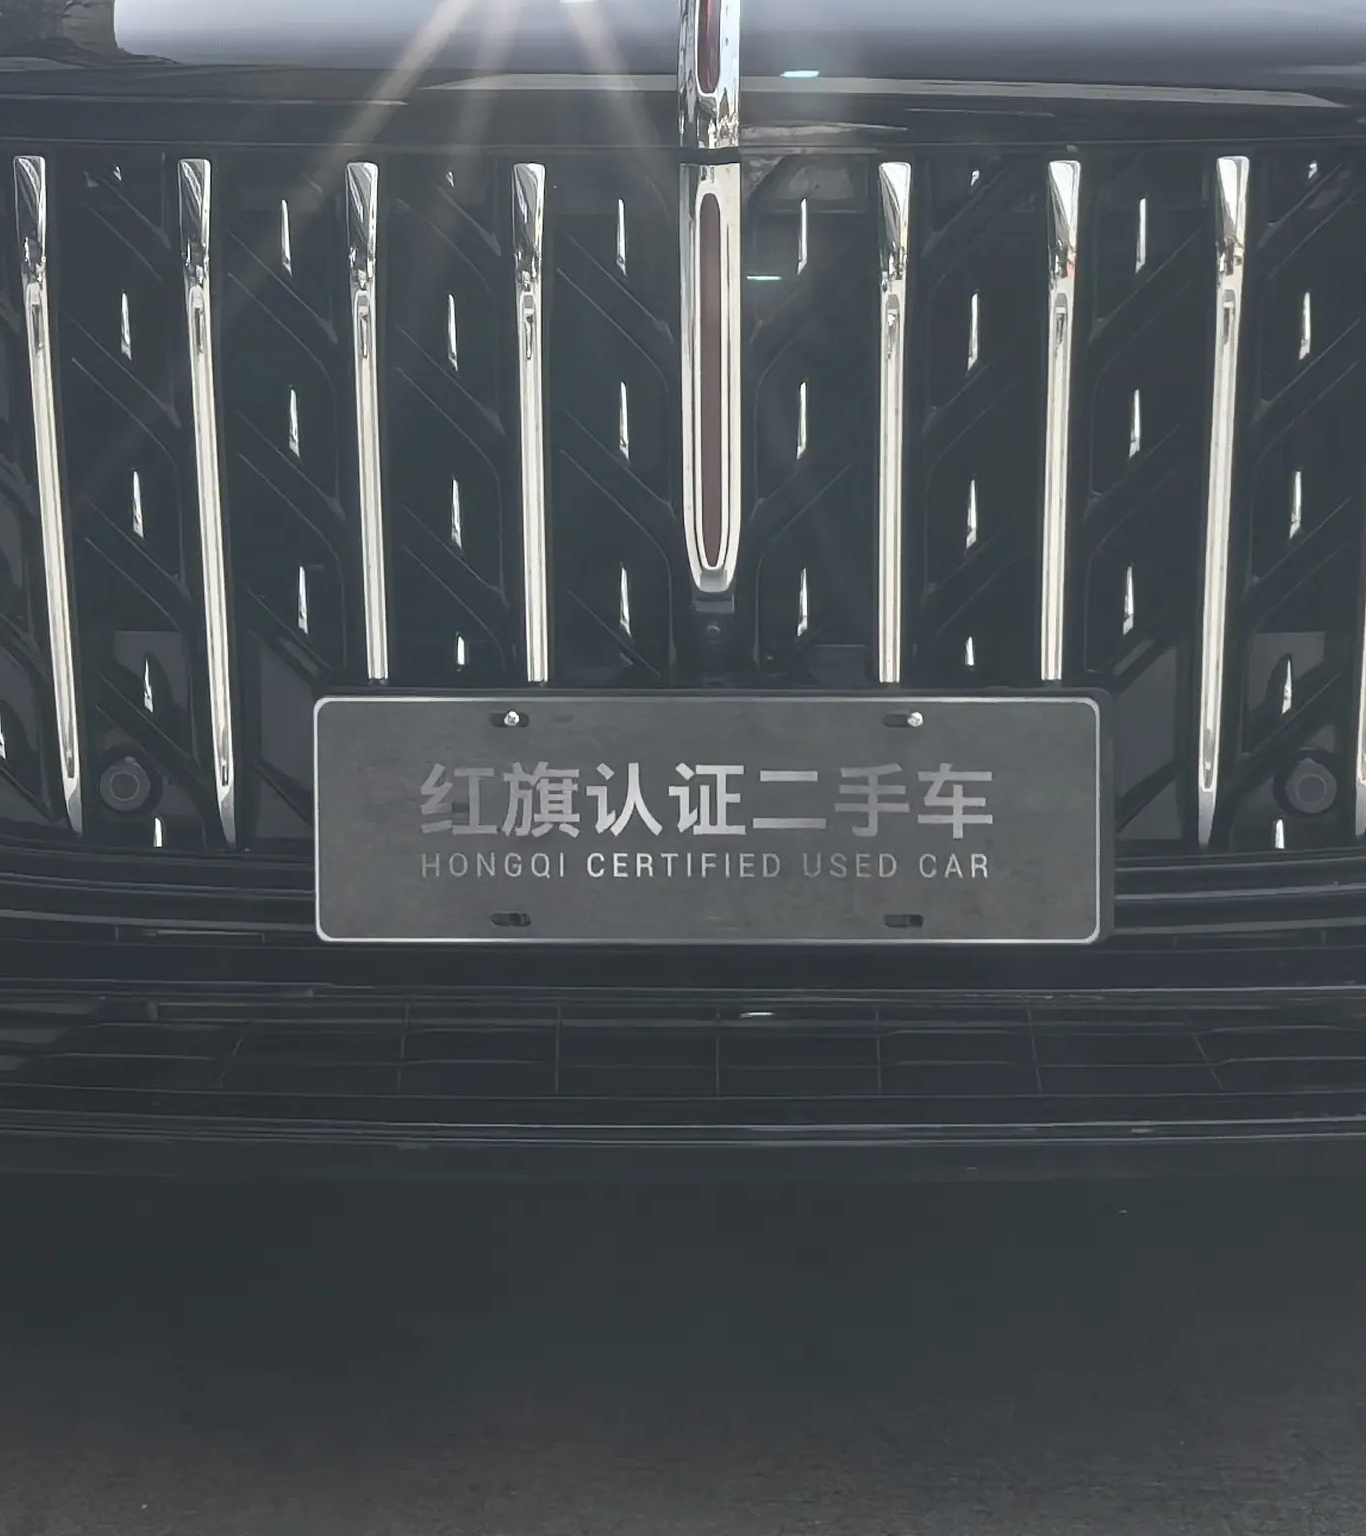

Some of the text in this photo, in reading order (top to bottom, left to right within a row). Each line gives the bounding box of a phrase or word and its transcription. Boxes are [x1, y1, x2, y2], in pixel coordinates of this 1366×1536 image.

[419, 761, 995, 840] 红旗认证二手车
[420, 851, 990, 880] HONGQI CERTIFIED USED CAR
